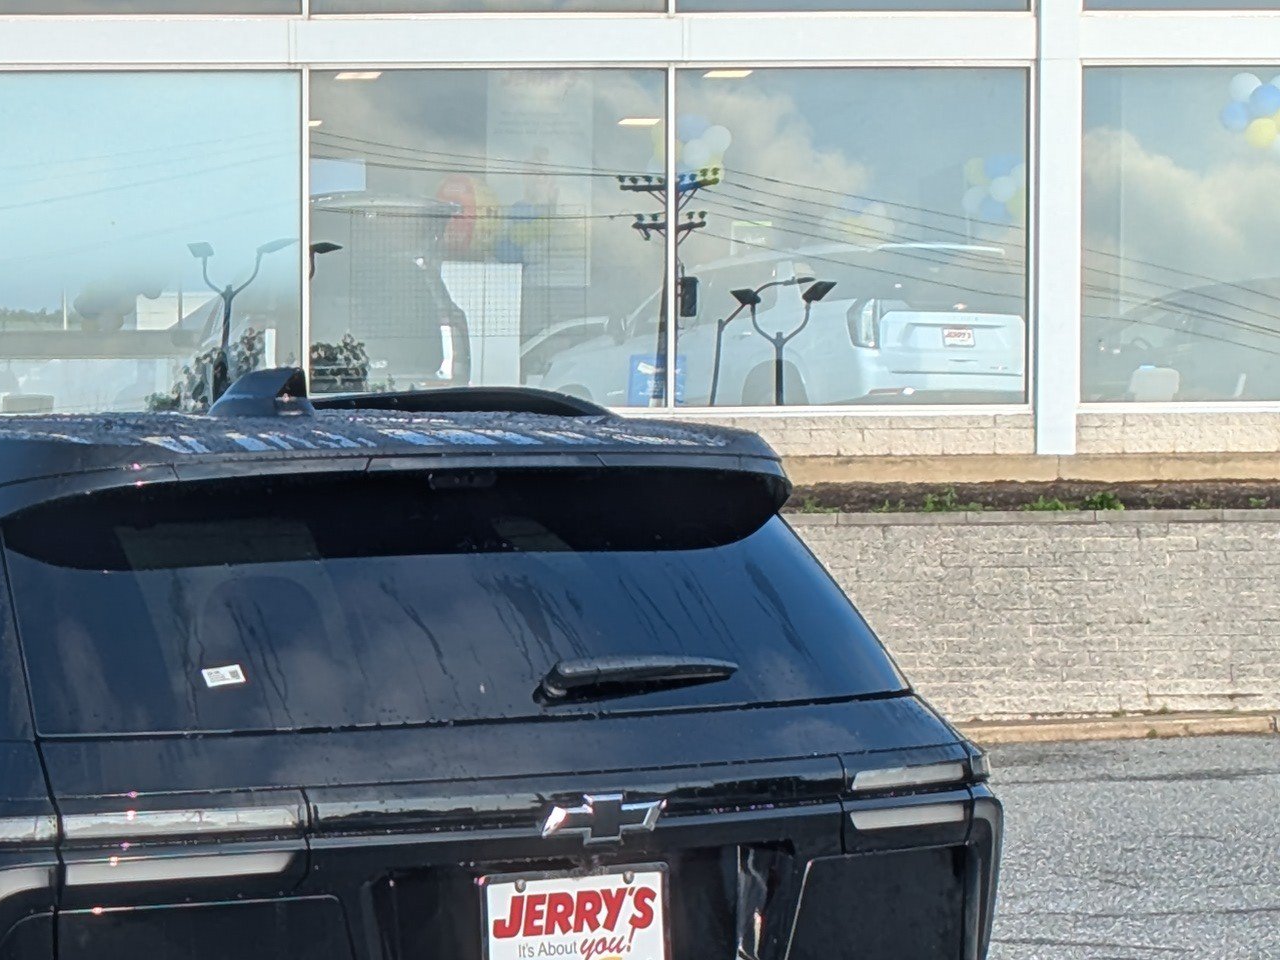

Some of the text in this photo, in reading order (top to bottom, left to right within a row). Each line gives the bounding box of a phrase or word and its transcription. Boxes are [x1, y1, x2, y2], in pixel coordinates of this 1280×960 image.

[492, 886, 657, 939] JERRY'S
[518, 943, 535, 958] It's
[537, 940, 578, 957] About
